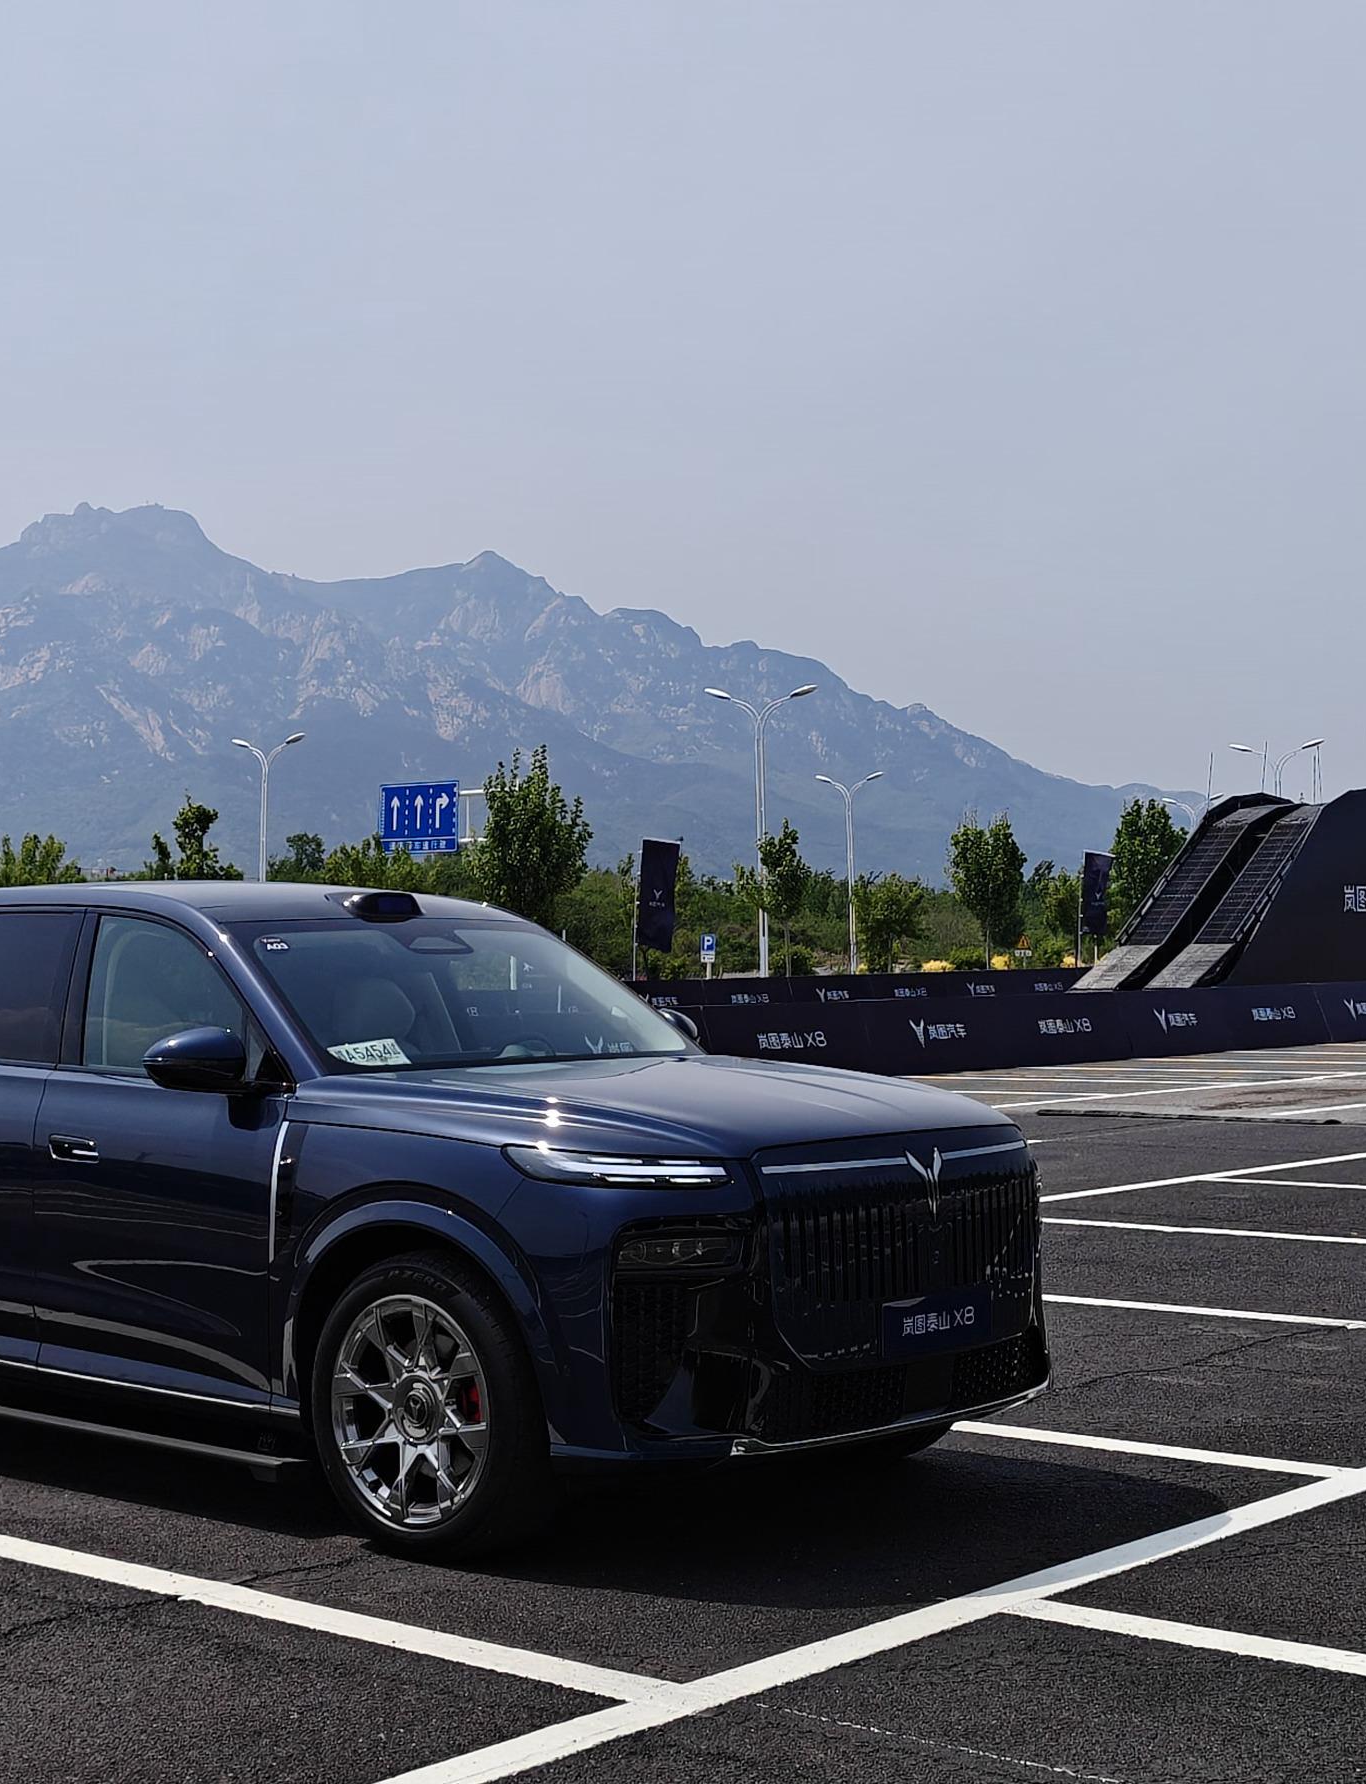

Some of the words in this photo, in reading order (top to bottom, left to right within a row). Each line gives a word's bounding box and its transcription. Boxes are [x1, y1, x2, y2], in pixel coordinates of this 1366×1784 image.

[901, 1311, 951, 1337] 岚图泰山
[953, 1305, 975, 1328] X8
